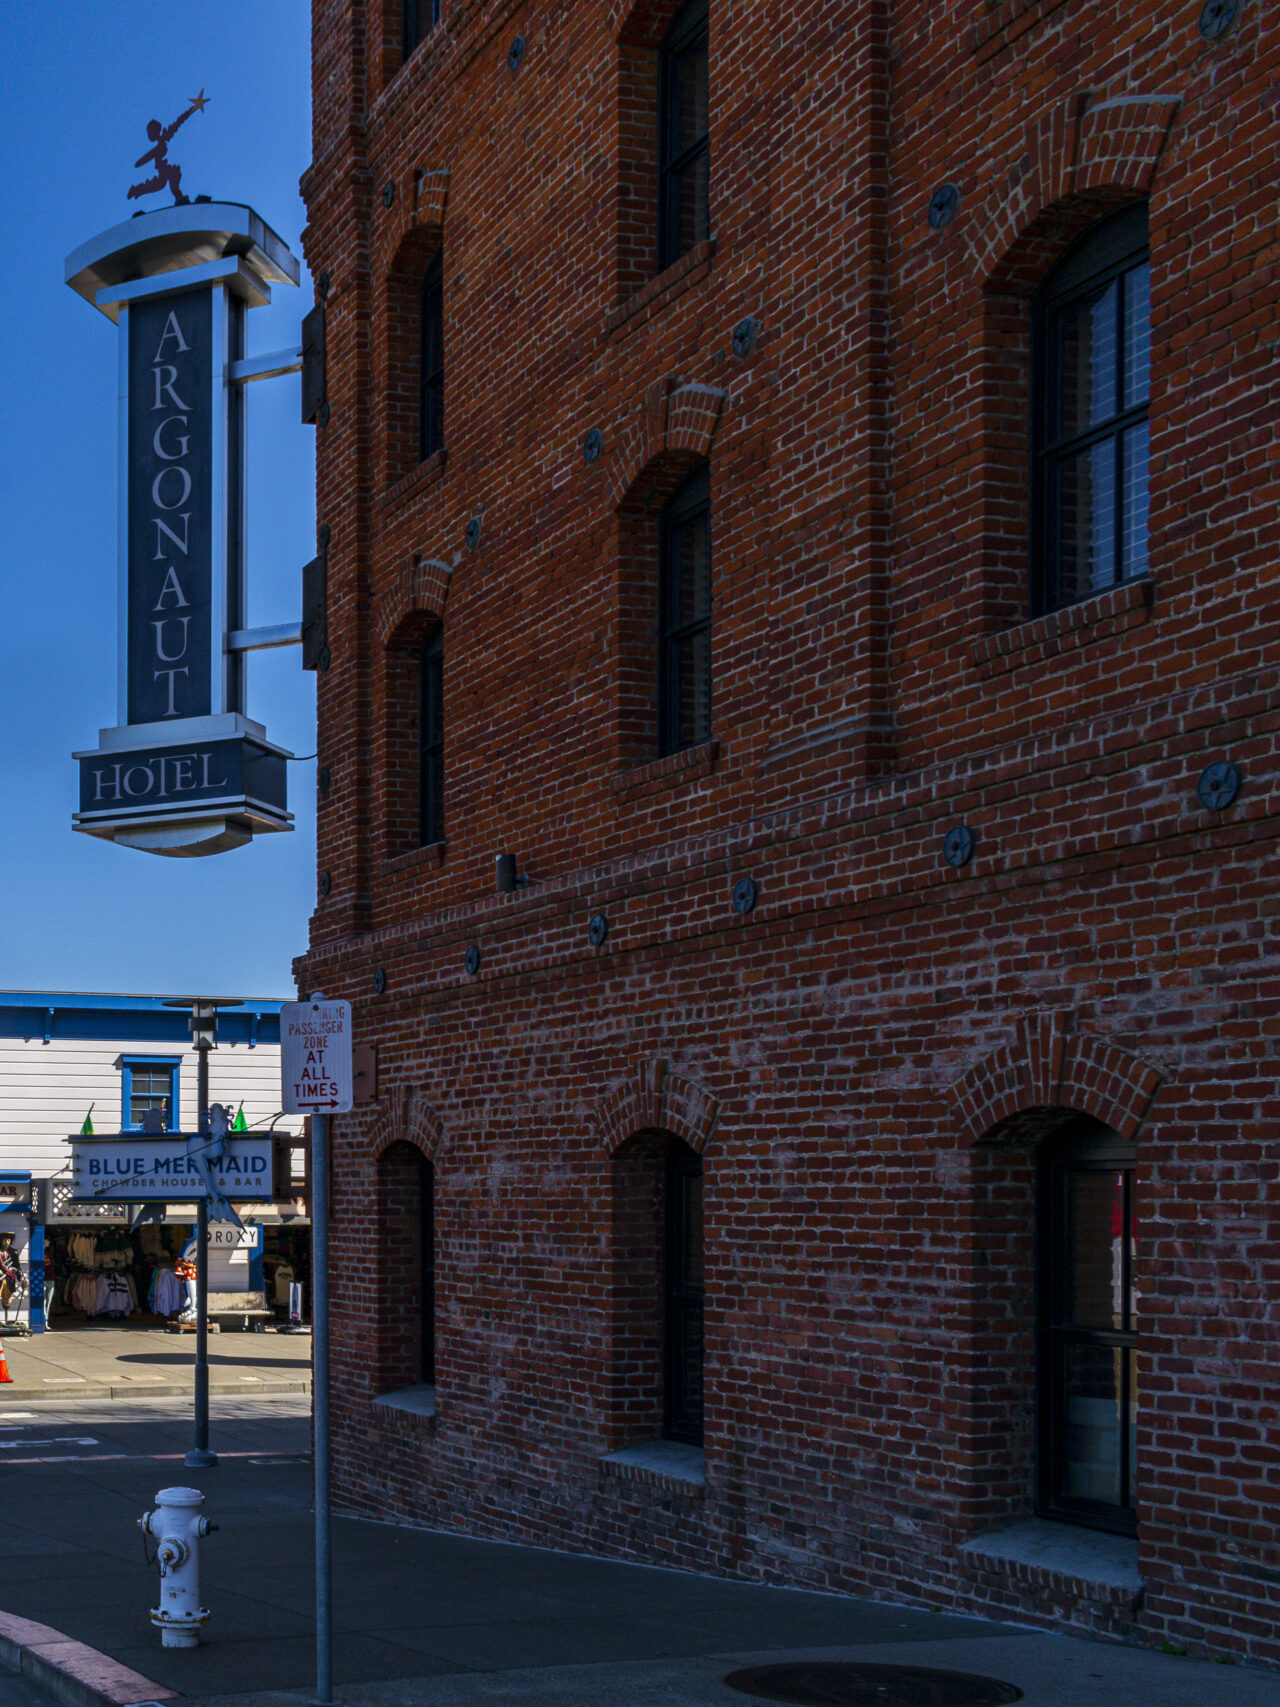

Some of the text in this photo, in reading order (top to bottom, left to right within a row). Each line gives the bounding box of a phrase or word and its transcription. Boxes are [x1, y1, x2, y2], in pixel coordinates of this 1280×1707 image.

[151, 310, 194, 716] ARGONAUT
[90, 752, 228, 801] HOTEL
[303, 1036, 329, 1049] ZONE
[306, 1050, 325, 1064] AT
[301, 1066, 331, 1081] ALL
[293, 1083, 339, 1098] TIMES
[88, 1156, 267, 1175] BLUE MERMAID
[92, 1177, 263, 1188] CHOWDER HOUSE & BAR
[215, 1230, 258, 1243] ROXY
